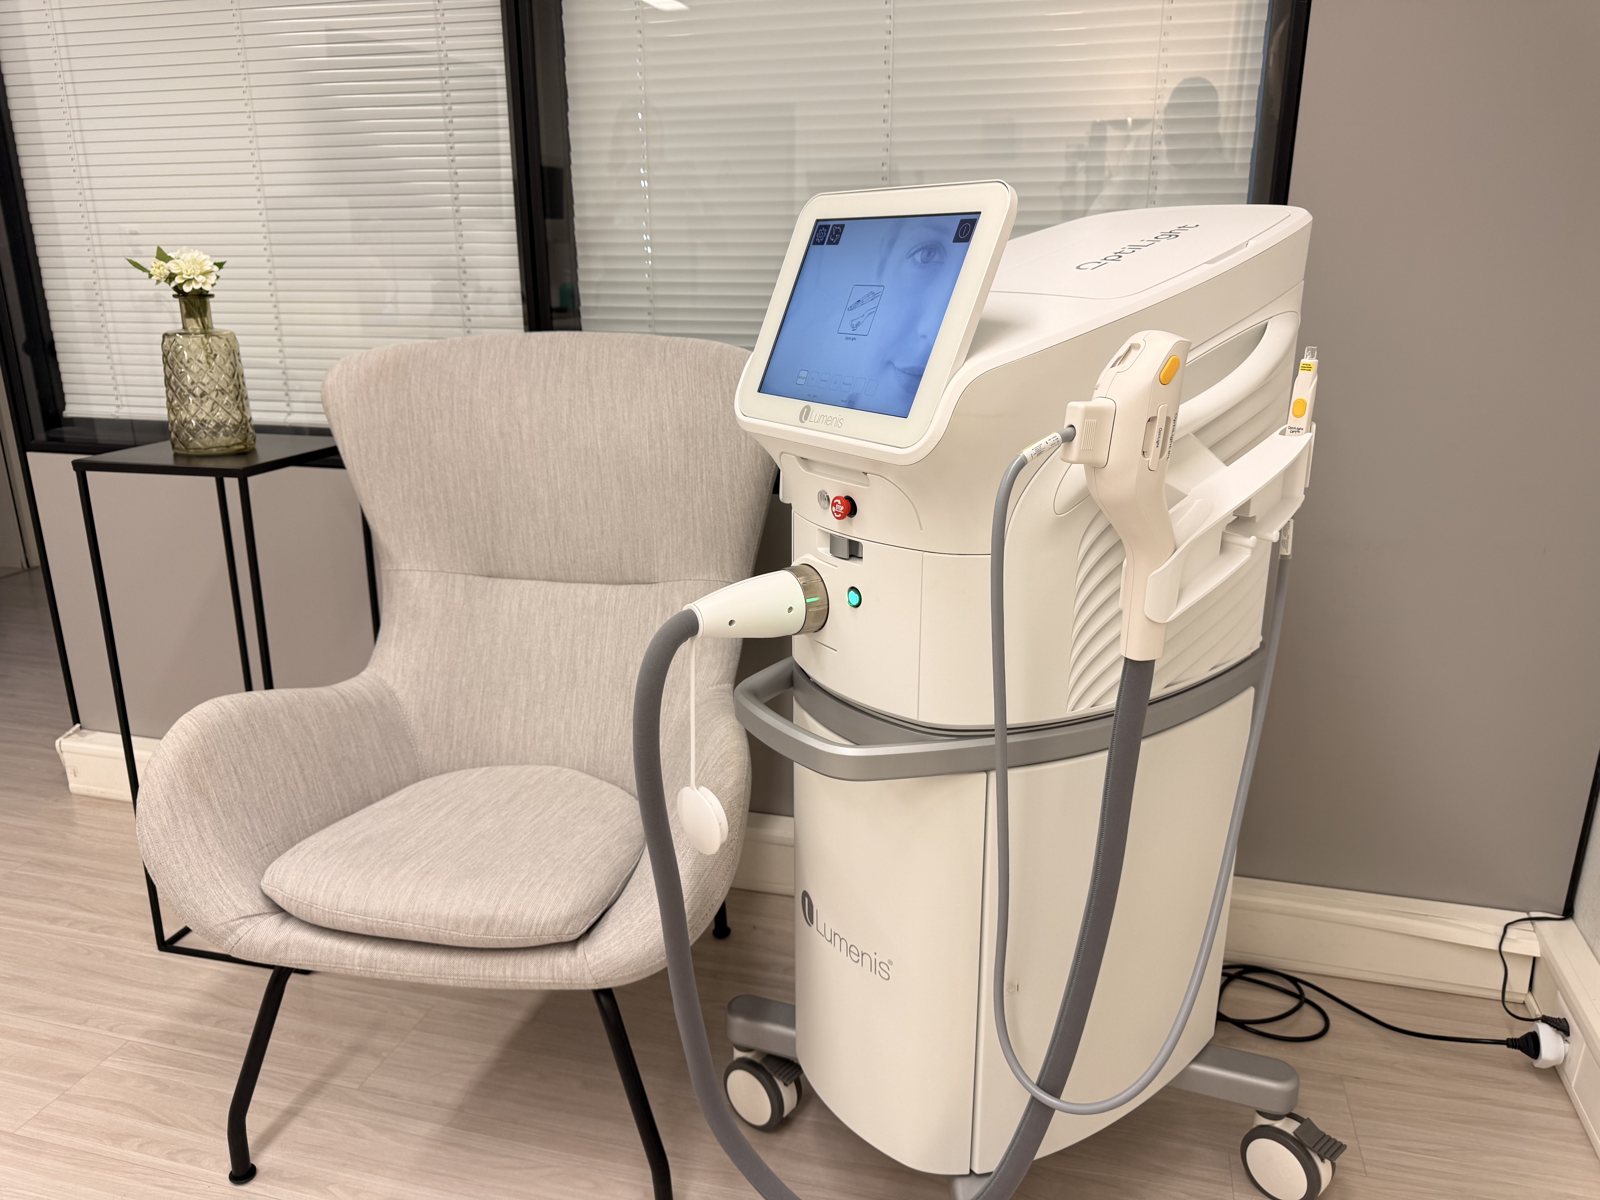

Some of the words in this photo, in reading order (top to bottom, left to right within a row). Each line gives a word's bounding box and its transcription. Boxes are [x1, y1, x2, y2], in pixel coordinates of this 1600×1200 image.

[1075, 224, 1200, 271] OptiLight
[808, 409, 845, 429] Lumenis
[815, 908, 891, 981] Lumenis
